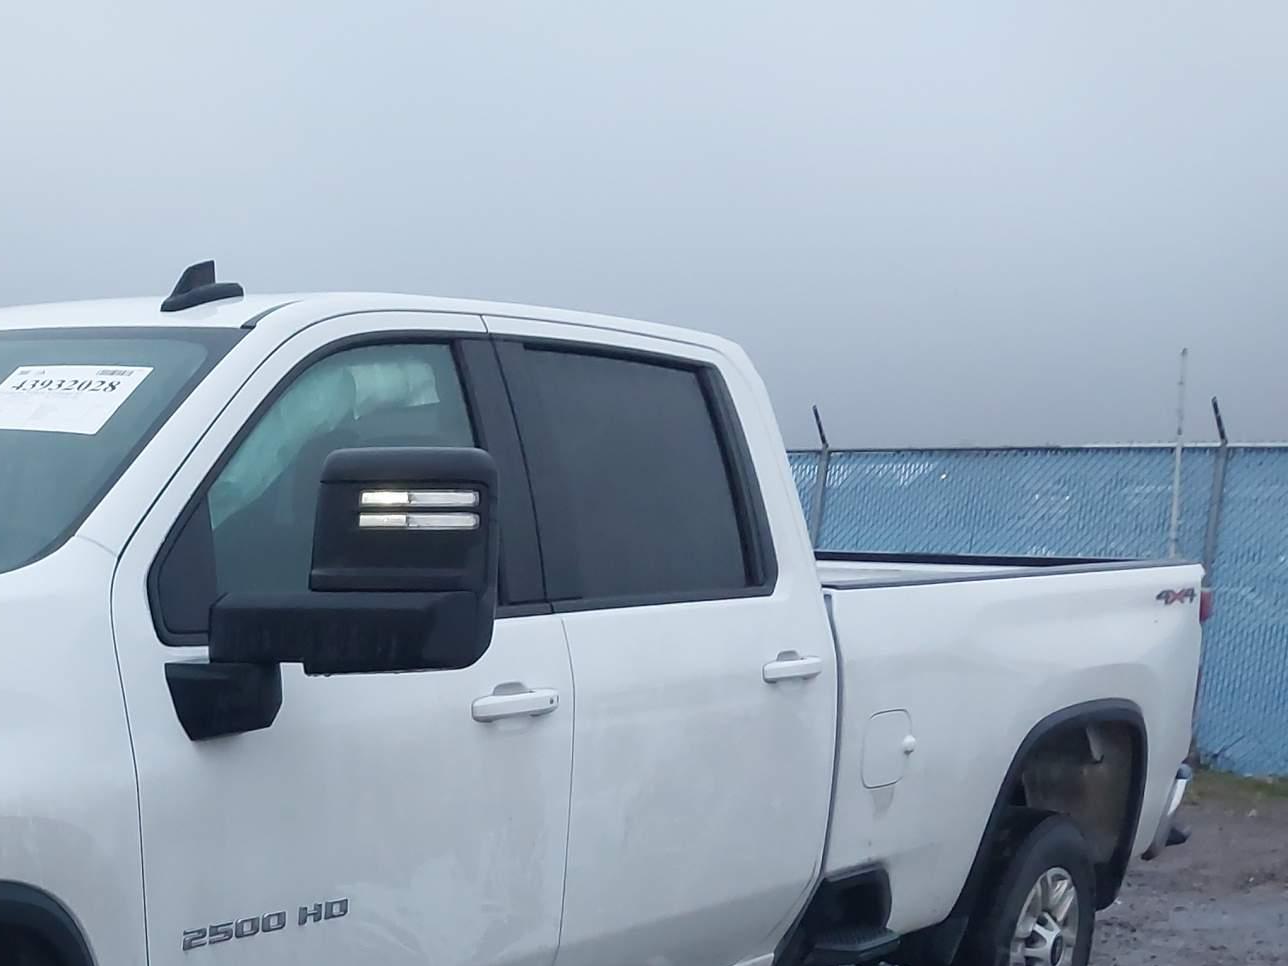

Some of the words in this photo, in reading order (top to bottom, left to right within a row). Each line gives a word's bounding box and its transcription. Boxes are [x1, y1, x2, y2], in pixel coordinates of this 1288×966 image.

[11, 379, 121, 393] 43932028
[182, 911, 287, 951] 2500
[298, 897, 349, 926] HD
